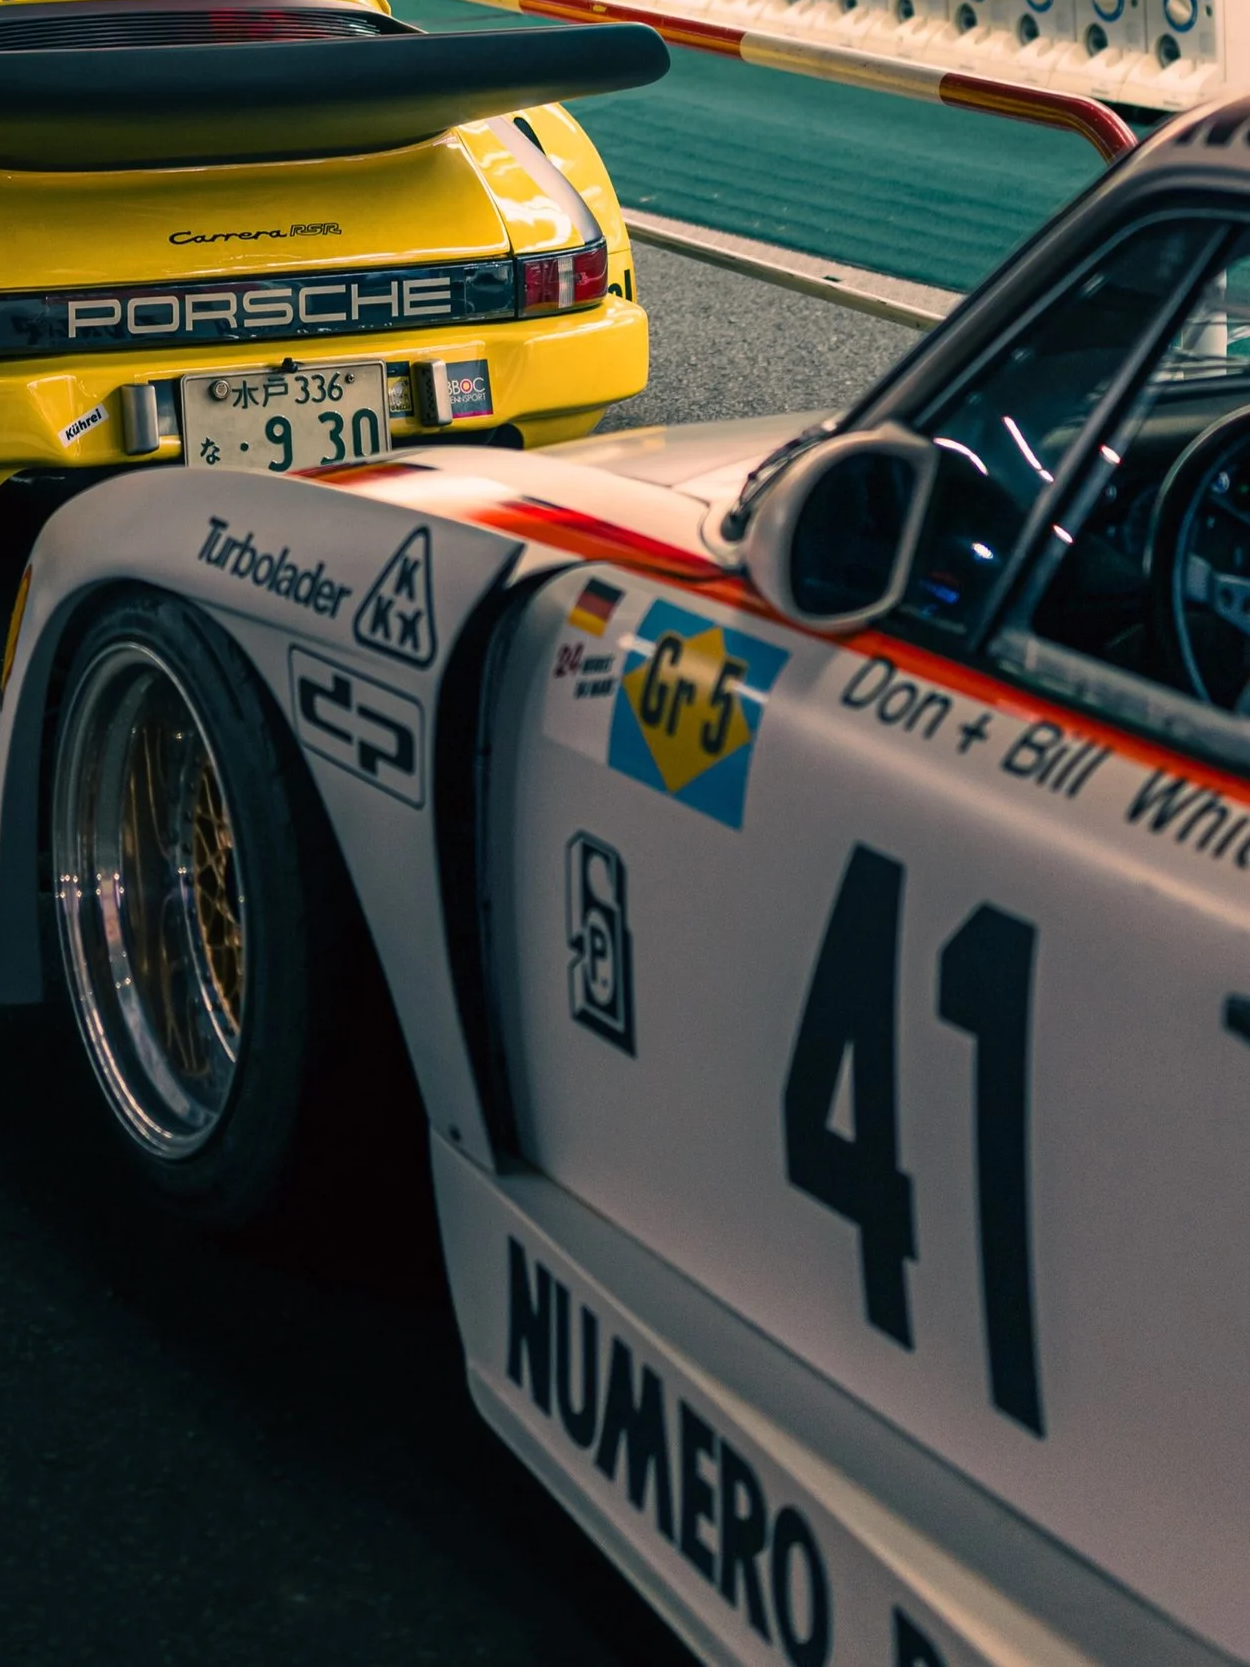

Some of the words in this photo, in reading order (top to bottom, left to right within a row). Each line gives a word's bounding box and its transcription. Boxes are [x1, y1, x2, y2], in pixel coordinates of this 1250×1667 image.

[168, 226, 287, 245] Carrera
[289, 221, 342, 238] RSR
[68, 277, 451, 338] PORSCHE
[231, 375, 290, 409] 水戸
[294, 372, 345, 405] 336
[448, 392, 487, 404] ENNSPORT
[198, 515, 352, 621] Turbolader
[639, 634, 698, 738] Gr
[701, 657, 748, 755] 5
[840, 654, 952, 741] Don
[1001, 719, 1113, 801] Bill
[779, 838, 1049, 1441] 41
[506, 1233, 834, 1667] NUMERO
